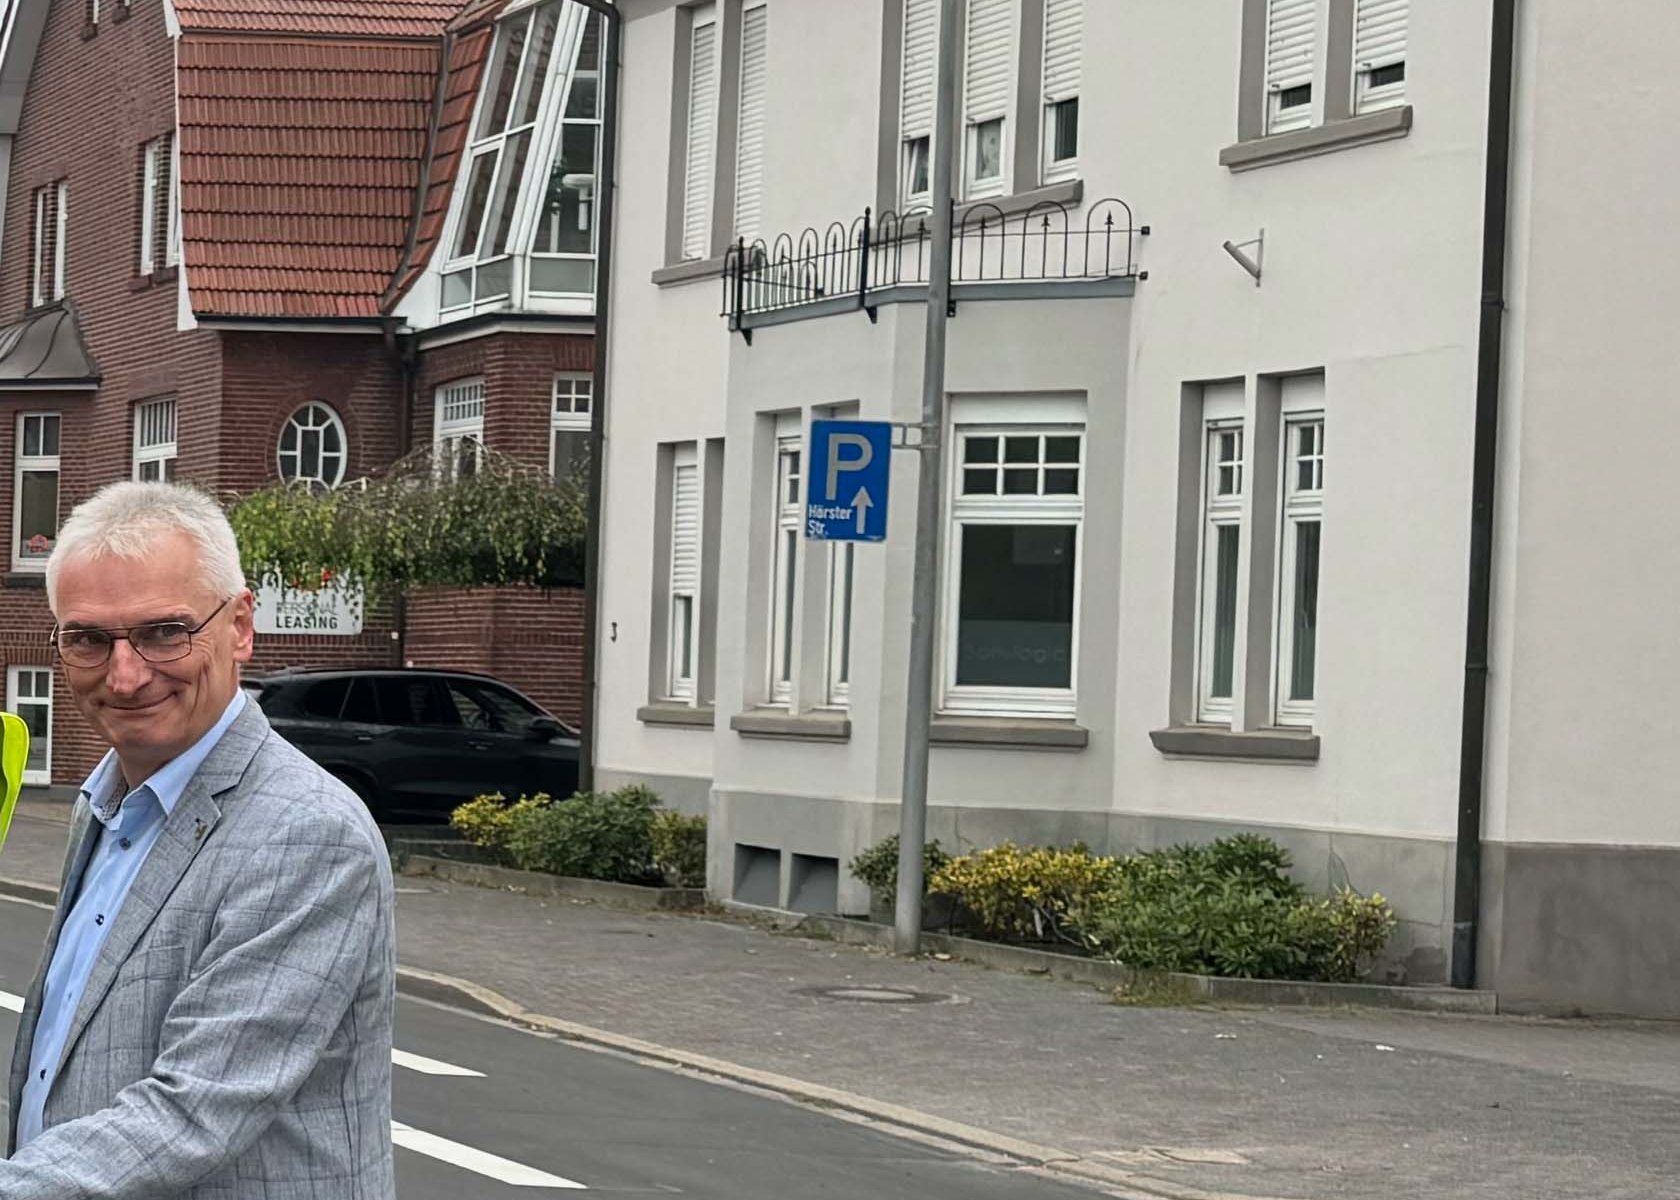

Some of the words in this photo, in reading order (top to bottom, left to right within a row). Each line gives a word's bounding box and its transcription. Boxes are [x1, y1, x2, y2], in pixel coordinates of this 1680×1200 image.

[826, 432, 873, 501] P
[807, 520, 829, 535] Str.
[275, 615, 338, 630] LEASING
